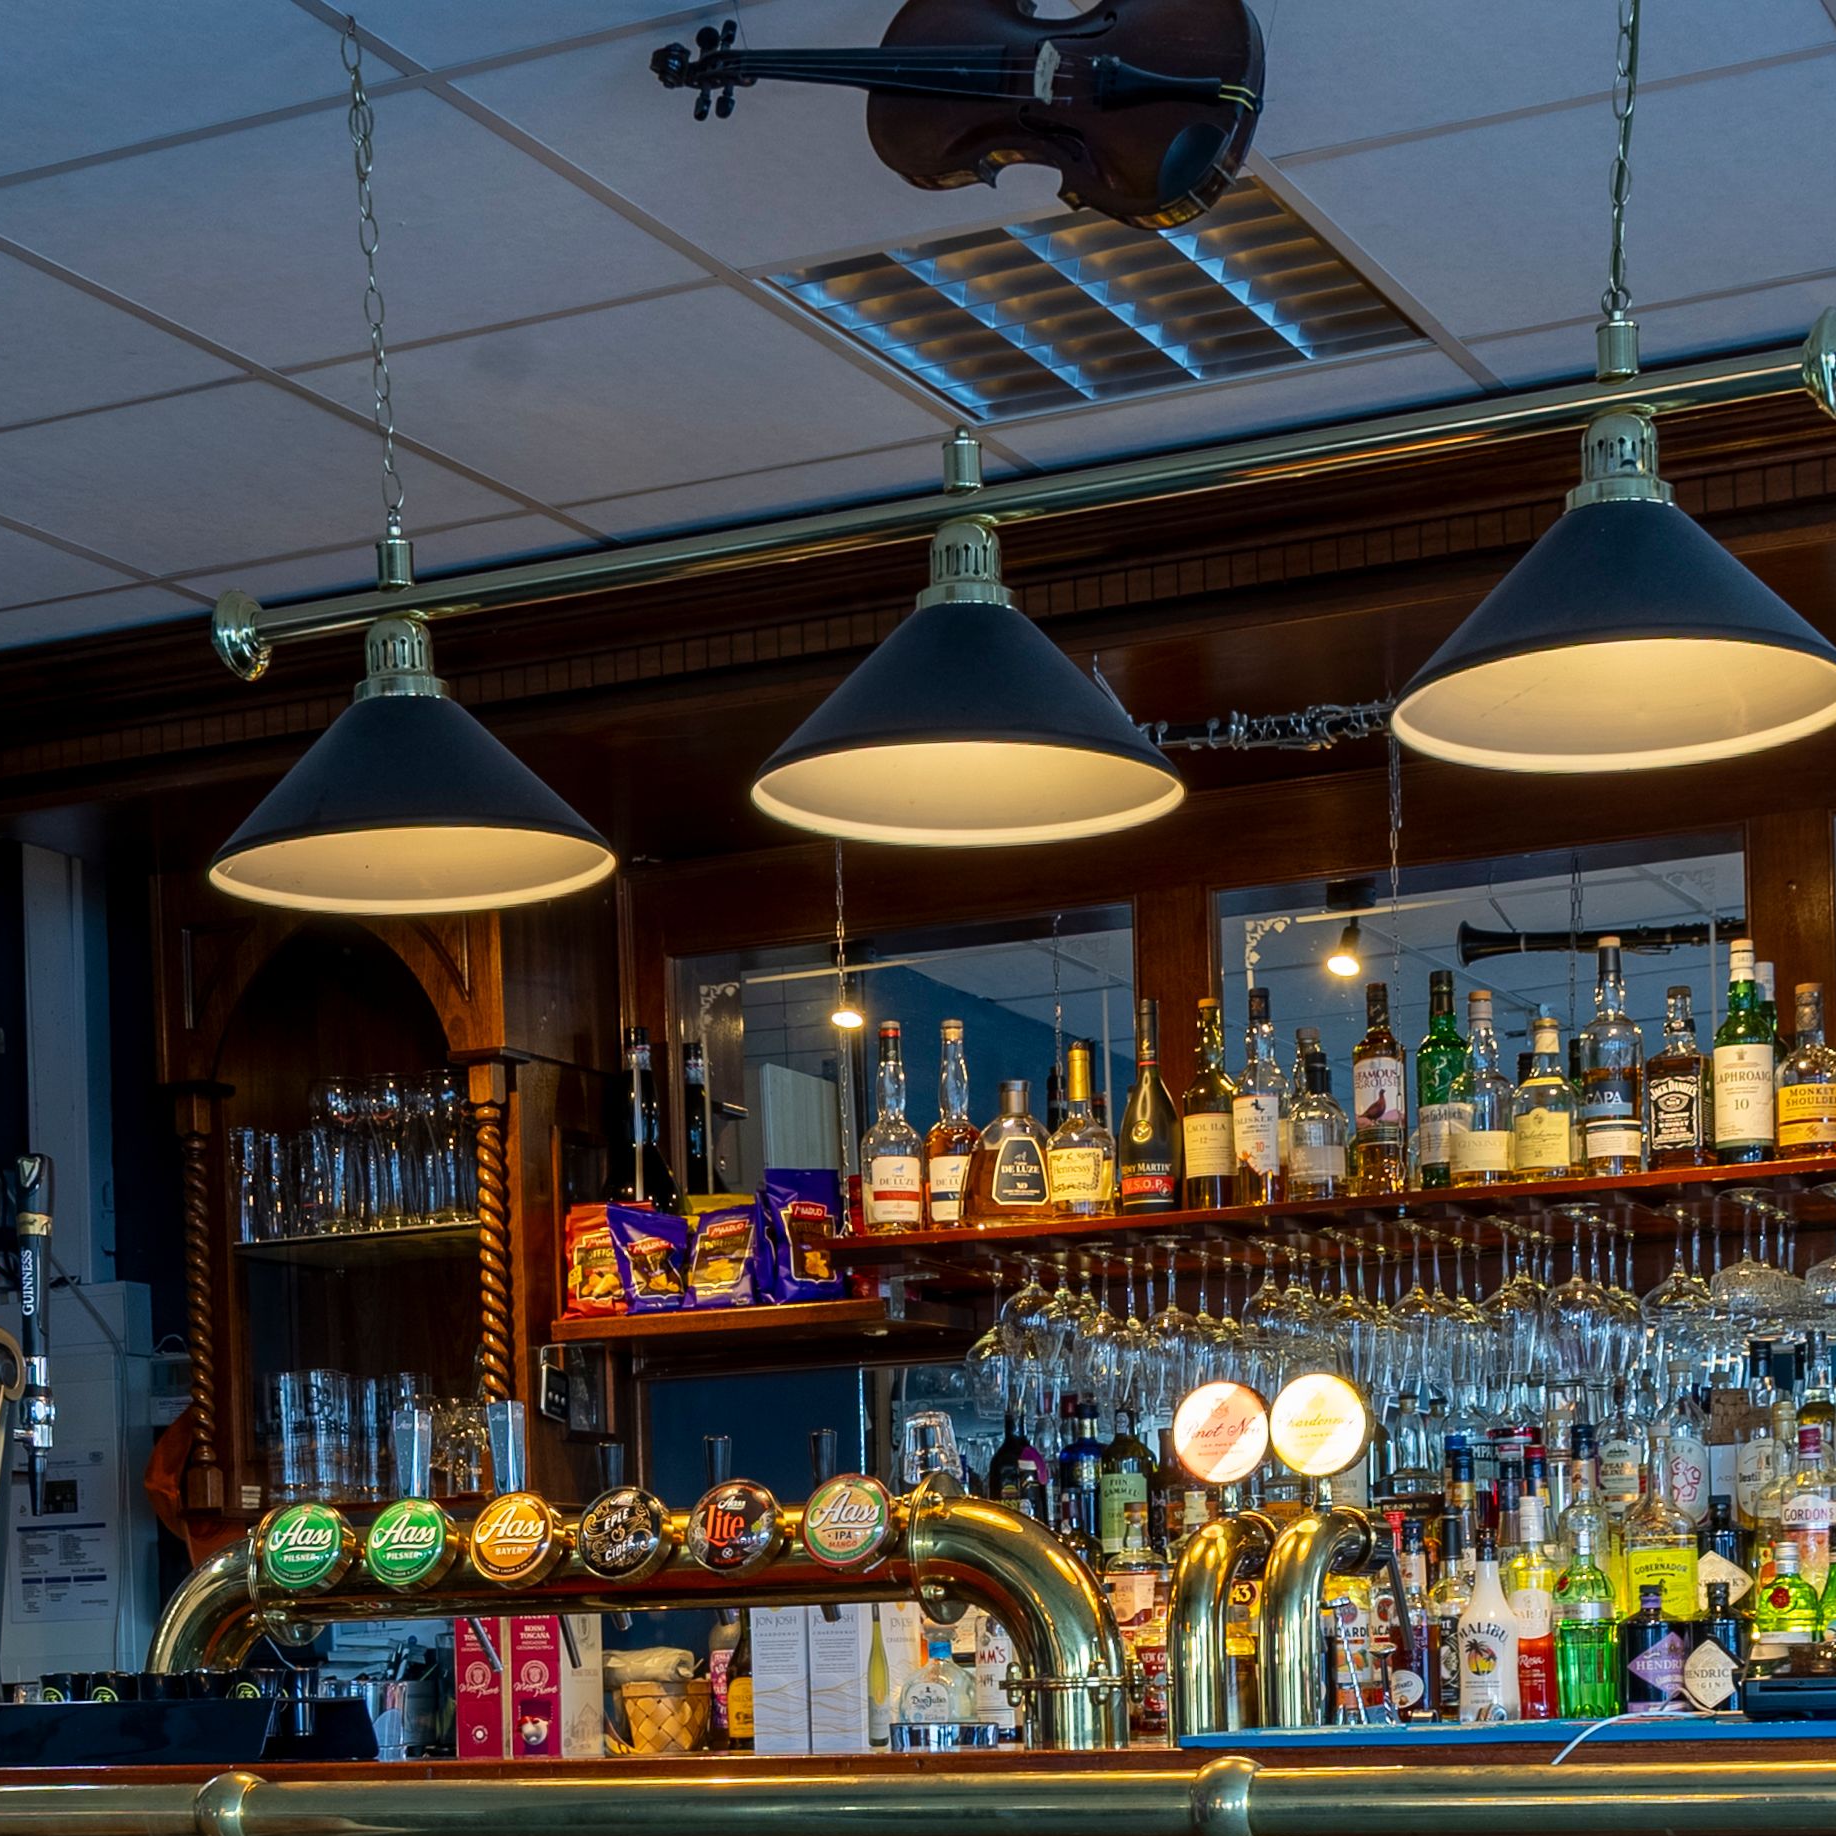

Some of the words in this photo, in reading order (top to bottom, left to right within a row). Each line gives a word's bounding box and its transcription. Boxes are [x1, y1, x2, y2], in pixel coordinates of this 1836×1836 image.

[1650, 1082, 1669, 1100] JACK
[1789, 1087, 1836, 1098] MONKEY
[1735, 1099, 1749, 1111] 10
[1186, 1124, 1209, 1134] CAOL
[1210, 1122, 1227, 1132] ILA
[1001, 1164, 1015, 1174] DE
[1015, 1164, 1040, 1174] LUZE
[1053, 1164, 1093, 1175] Hennessy
[1137, 1162, 1170, 1173] MARTIN
[879, 1178, 890, 1187] DE
[893, 1177, 915, 1186] LUZE
[935, 1178, 944, 1187] DE
[712, 1222, 745, 1236] MAARUD
[21, 1248, 35, 1316] GUINNESS
[1103, 1486, 1140, 1498] GAMMEL
[717, 1495, 746, 1511] Aass
[808, 1490, 883, 1532] Aass
[1783, 1506, 1836, 1522] GORDON'S
[604, 1507, 631, 1531] EPLE
[705, 1503, 745, 1543] Lite
[371, 1512, 438, 1551] Aass
[474, 1505, 546, 1546] Aass
[268, 1515, 334, 1553] Aass
[834, 1530, 853, 1540] IPA
[604, 1535, 635, 1562] CIDER
[828, 1540, 858, 1549] MANGO
[385, 1552, 425, 1562] PILSNER
[495, 1546, 529, 1556] BAYER
[282, 1552, 321, 1563] PILSNER
[1634, 1563, 1688, 1575] GOBERNADOR
[755, 1615, 773, 1629] JON
[775, 1615, 797, 1628] JOSH
[524, 1624, 546, 1633] ROSSO
[1457, 1620, 1509, 1643] MALIBU
[519, 1631, 551, 1640] TOSCANA
[1518, 1653, 1545, 1669] Rosa
[1701, 1682, 1721, 1690] GIN
